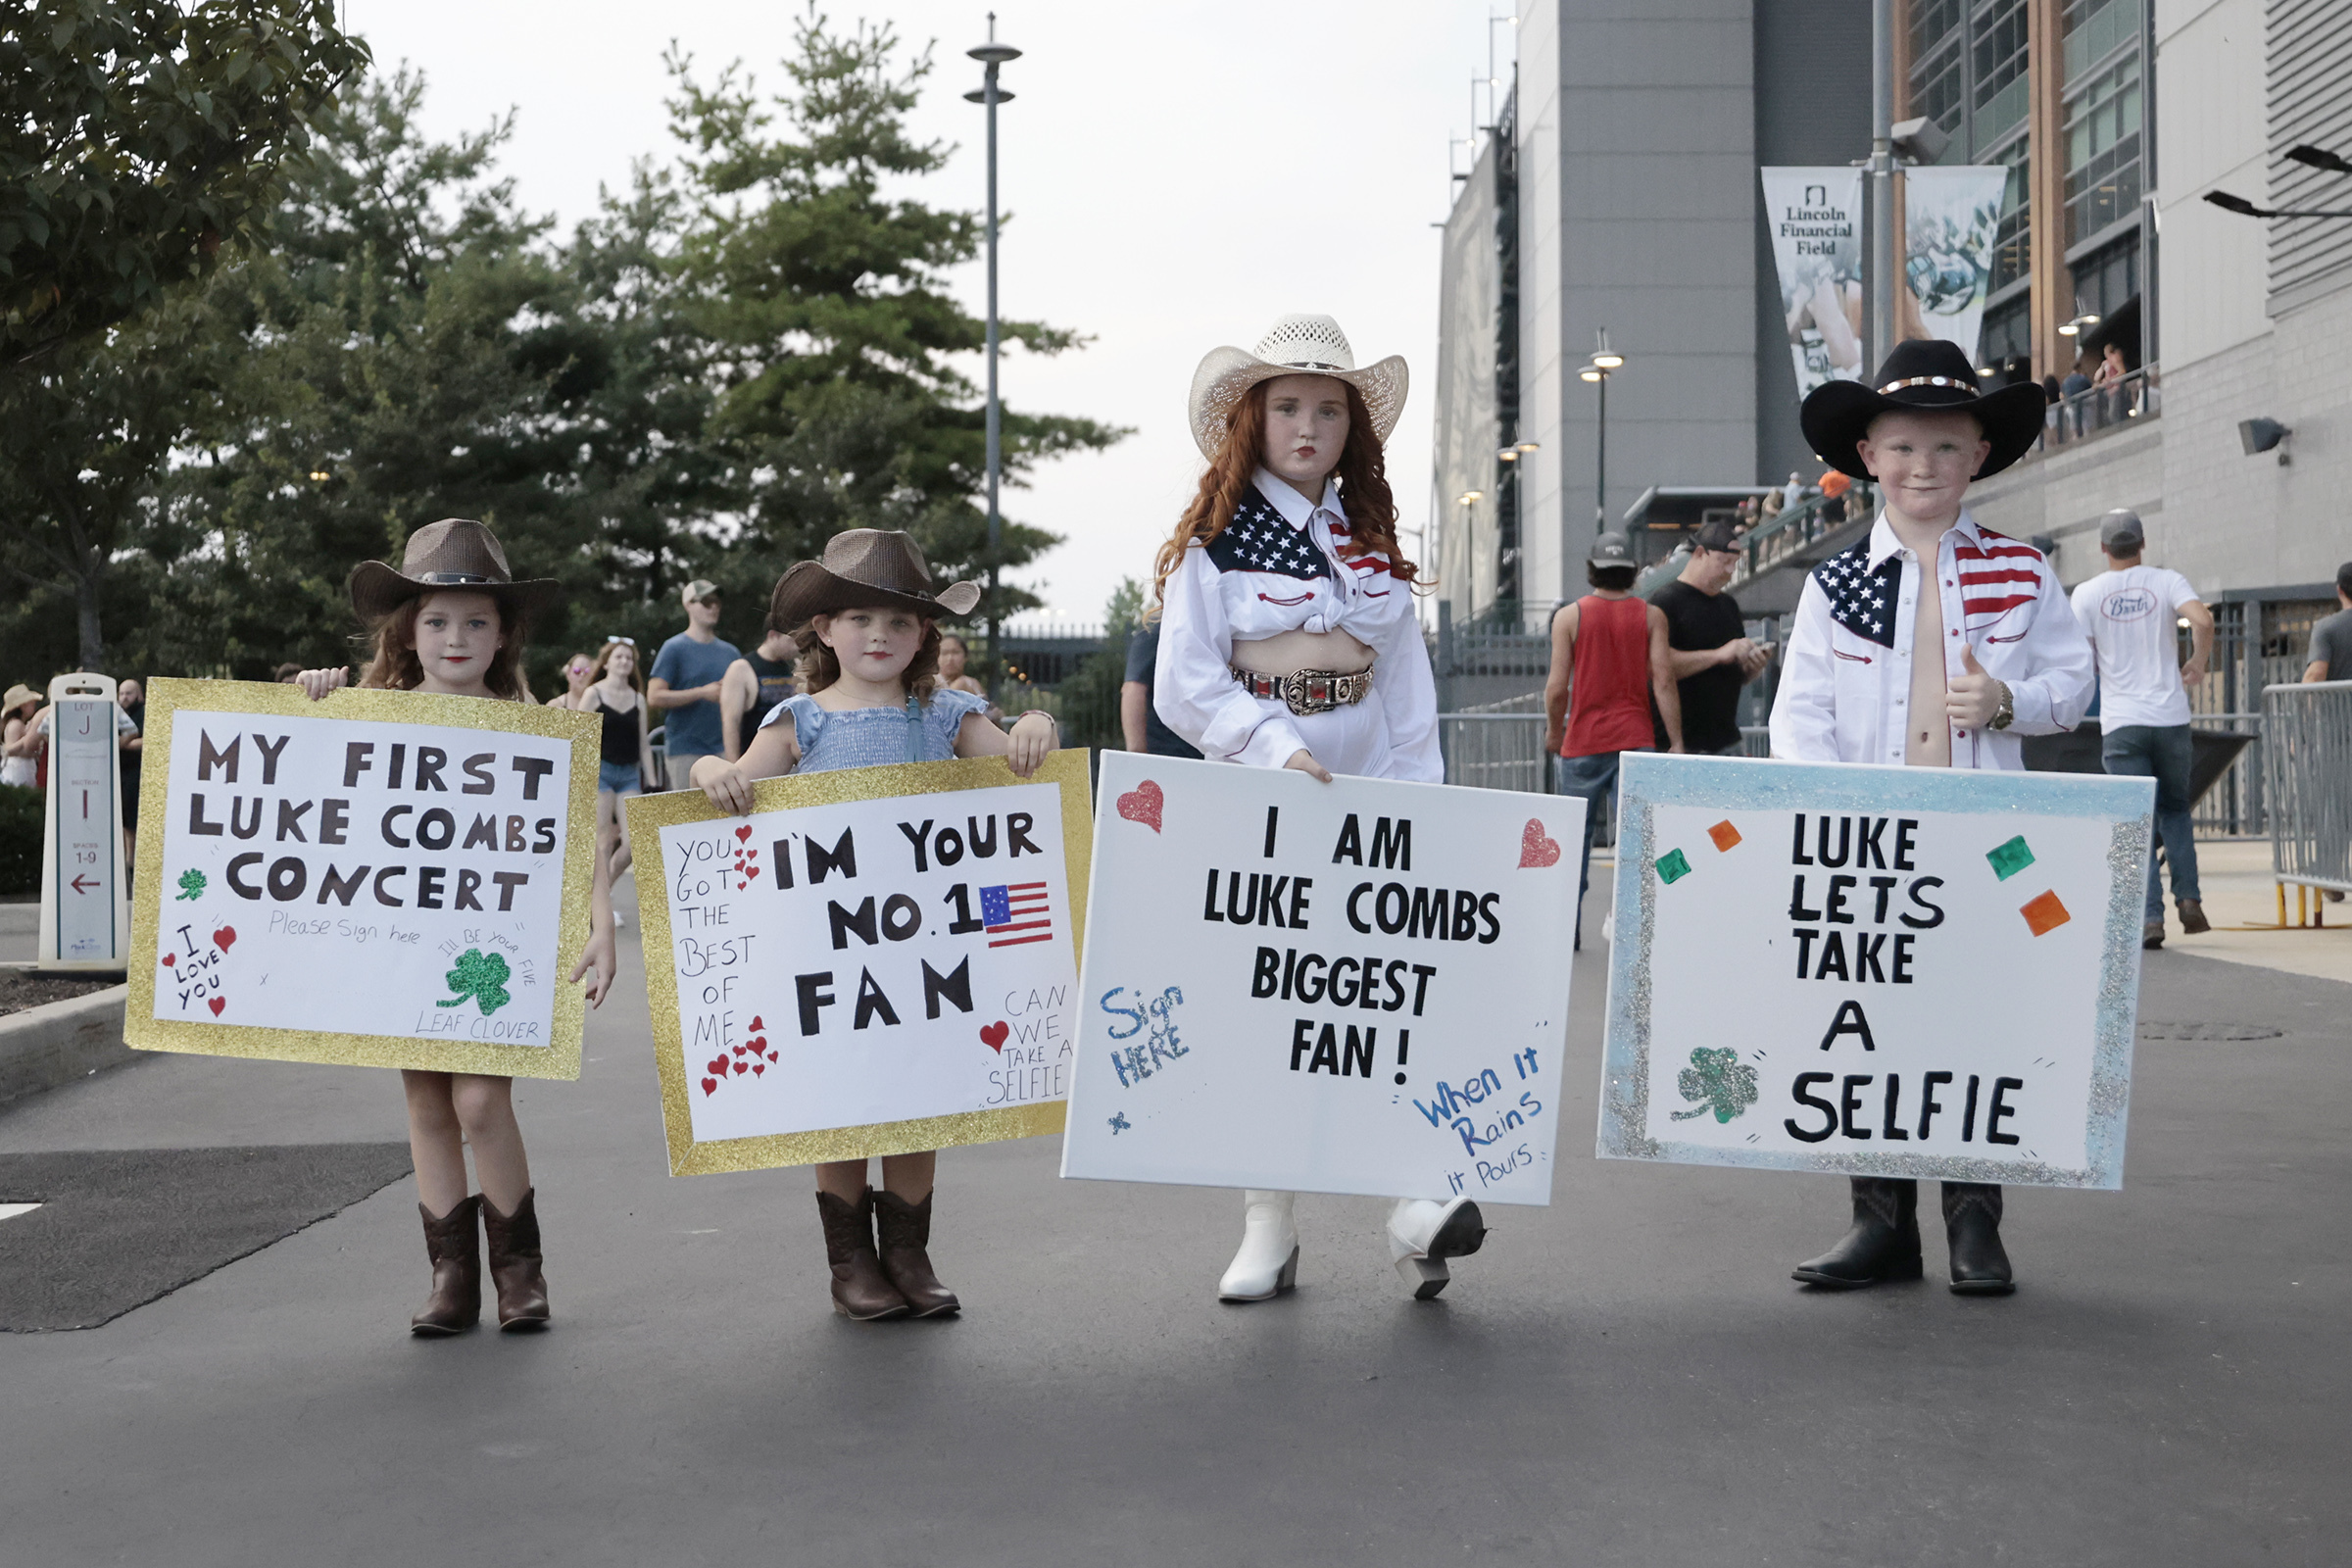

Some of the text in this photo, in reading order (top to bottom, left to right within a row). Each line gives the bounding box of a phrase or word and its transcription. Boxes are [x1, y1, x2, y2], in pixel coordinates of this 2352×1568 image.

[1780, 222, 1852, 237] Financial
[1787, 207, 1845, 220] Lincoln
[1796, 241, 1836, 255] Field
[74, 702, 94, 711] LOT
[78, 714, 90, 735] J
[197, 728, 554, 800] MY FIRST
[189, 793, 557, 854] LUKE COMBS
[897, 812, 1043, 872] YOUR
[1263, 806, 1412, 871] I AM
[1792, 812, 1919, 871] LUKE
[75, 851, 96, 863] 1-9
[676, 838, 731, 878] YOU
[225, 852, 529, 911] CONCERT
[676, 869, 733, 903] GOT
[679, 903, 730, 929] THE
[1203, 868, 1500, 945] LUKE COMBS
[176, 924, 200, 957] I
[269, 909, 421, 945] Please Sign here
[175, 949, 220, 984] LOVE
[463, 928, 481, 943] BE
[487, 931, 519, 954] YOUR
[517, 958, 537, 987] FIVE
[679, 934, 757, 977] BEST
[1792, 928, 1916, 984] TAKE
[178, 974, 220, 1010] YOU
[703, 975, 739, 1004] OF
[795, 954, 974, 1037] FAN
[1004, 984, 1066, 1017] CAN
[1250, 946, 1437, 1017] BIGGEST
[416, 1009, 539, 1040] LEAF CLOVER
[694, 1009, 734, 1048] ME
[1012, 1013, 1060, 1046] WE
[1100, 986, 1184, 1038] Sign
[1819, 1000, 1876, 1053] A
[1003, 1039, 1073, 1069] TAKE A
[1110, 1025, 1190, 1090] HERE
[986, 1063, 1063, 1104] SELFIE
[1412, 1068, 1502, 1129] When
[1450, 1091, 1543, 1157] Rains
[1784, 1070, 2024, 1146] SELFIE
